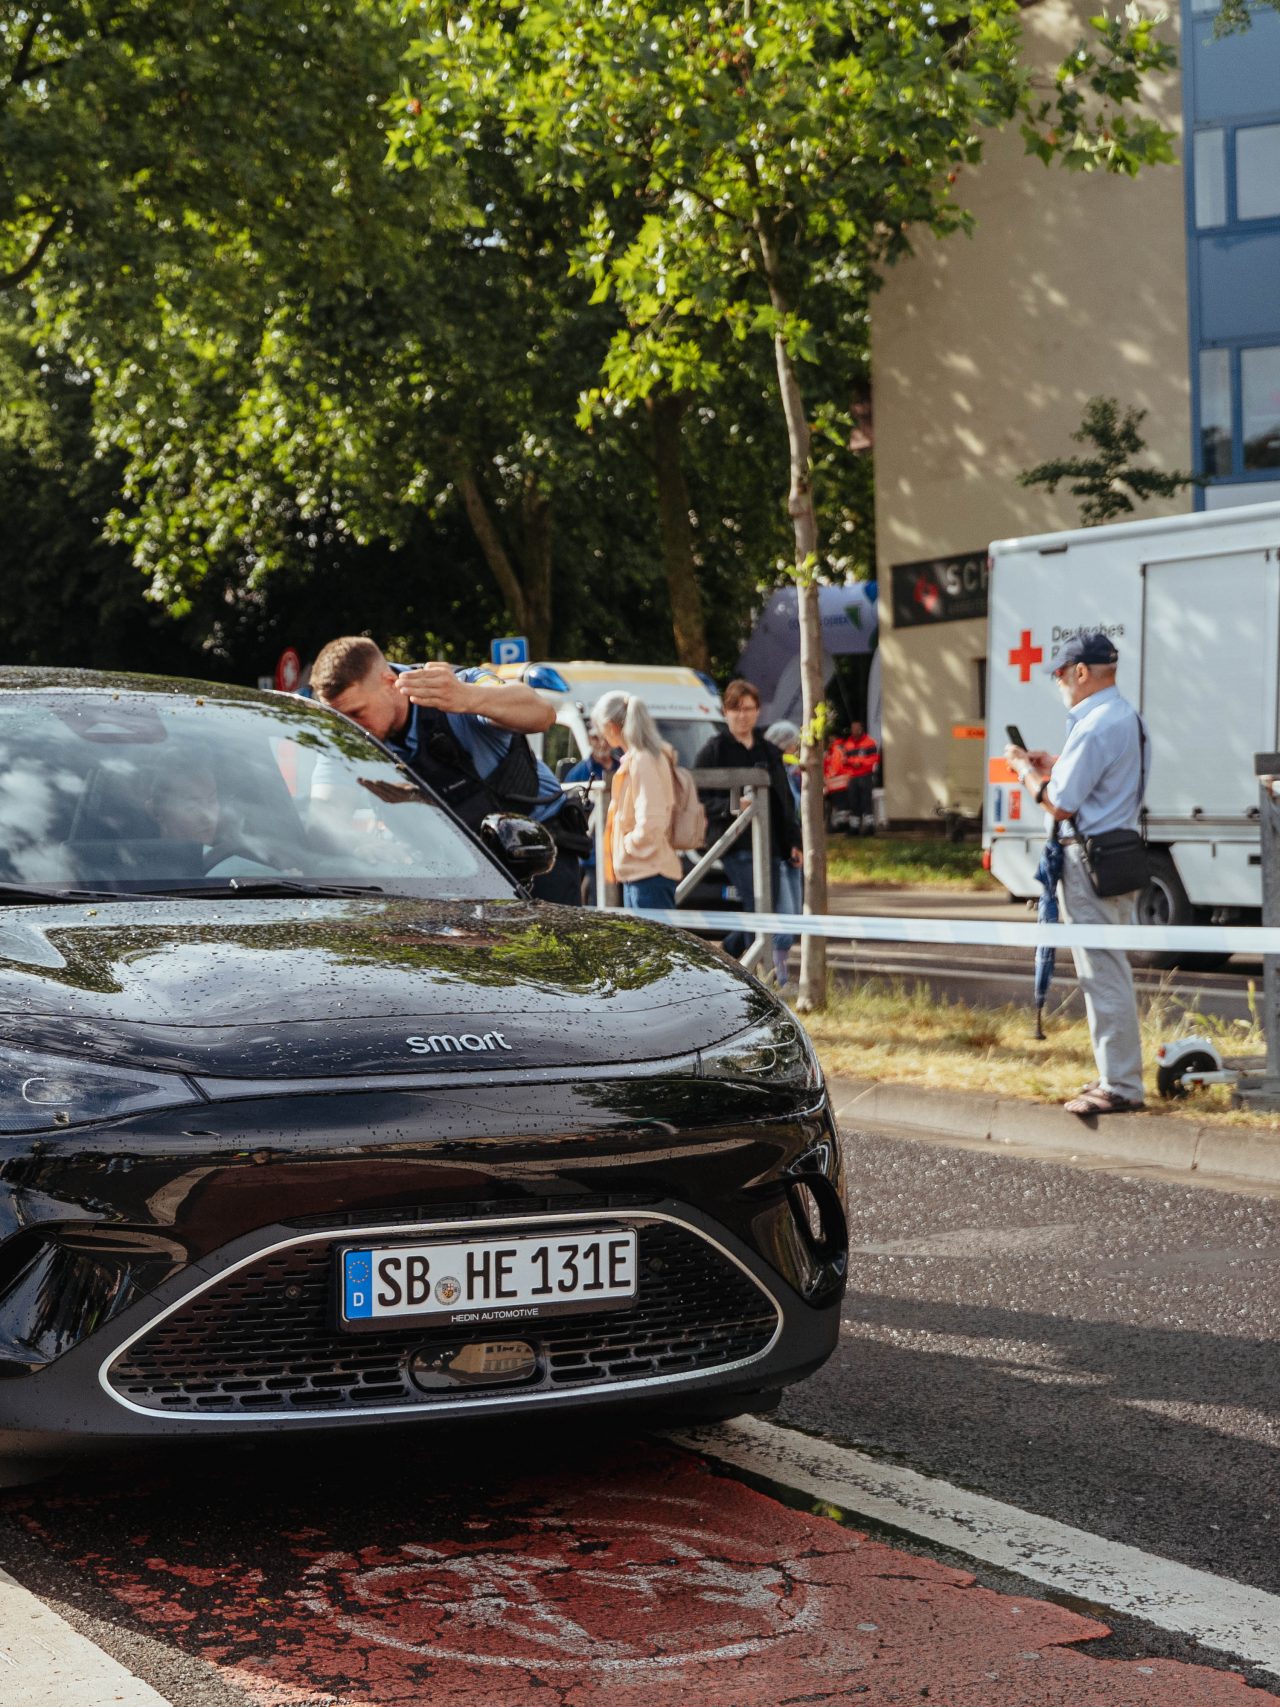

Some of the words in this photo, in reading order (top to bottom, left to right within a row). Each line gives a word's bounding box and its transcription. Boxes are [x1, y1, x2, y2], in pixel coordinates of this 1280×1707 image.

[500, 643, 519, 664] P
[406, 1031, 513, 1054] smart
[377, 1255, 431, 1307] SB
[466, 1249, 518, 1301] HE
[531, 1239, 631, 1296] 131E
[353, 1292, 365, 1307] D
[451, 1313, 479, 1323] HEDIN
[481, 1307, 539, 1320] AUTOMOTIVE
